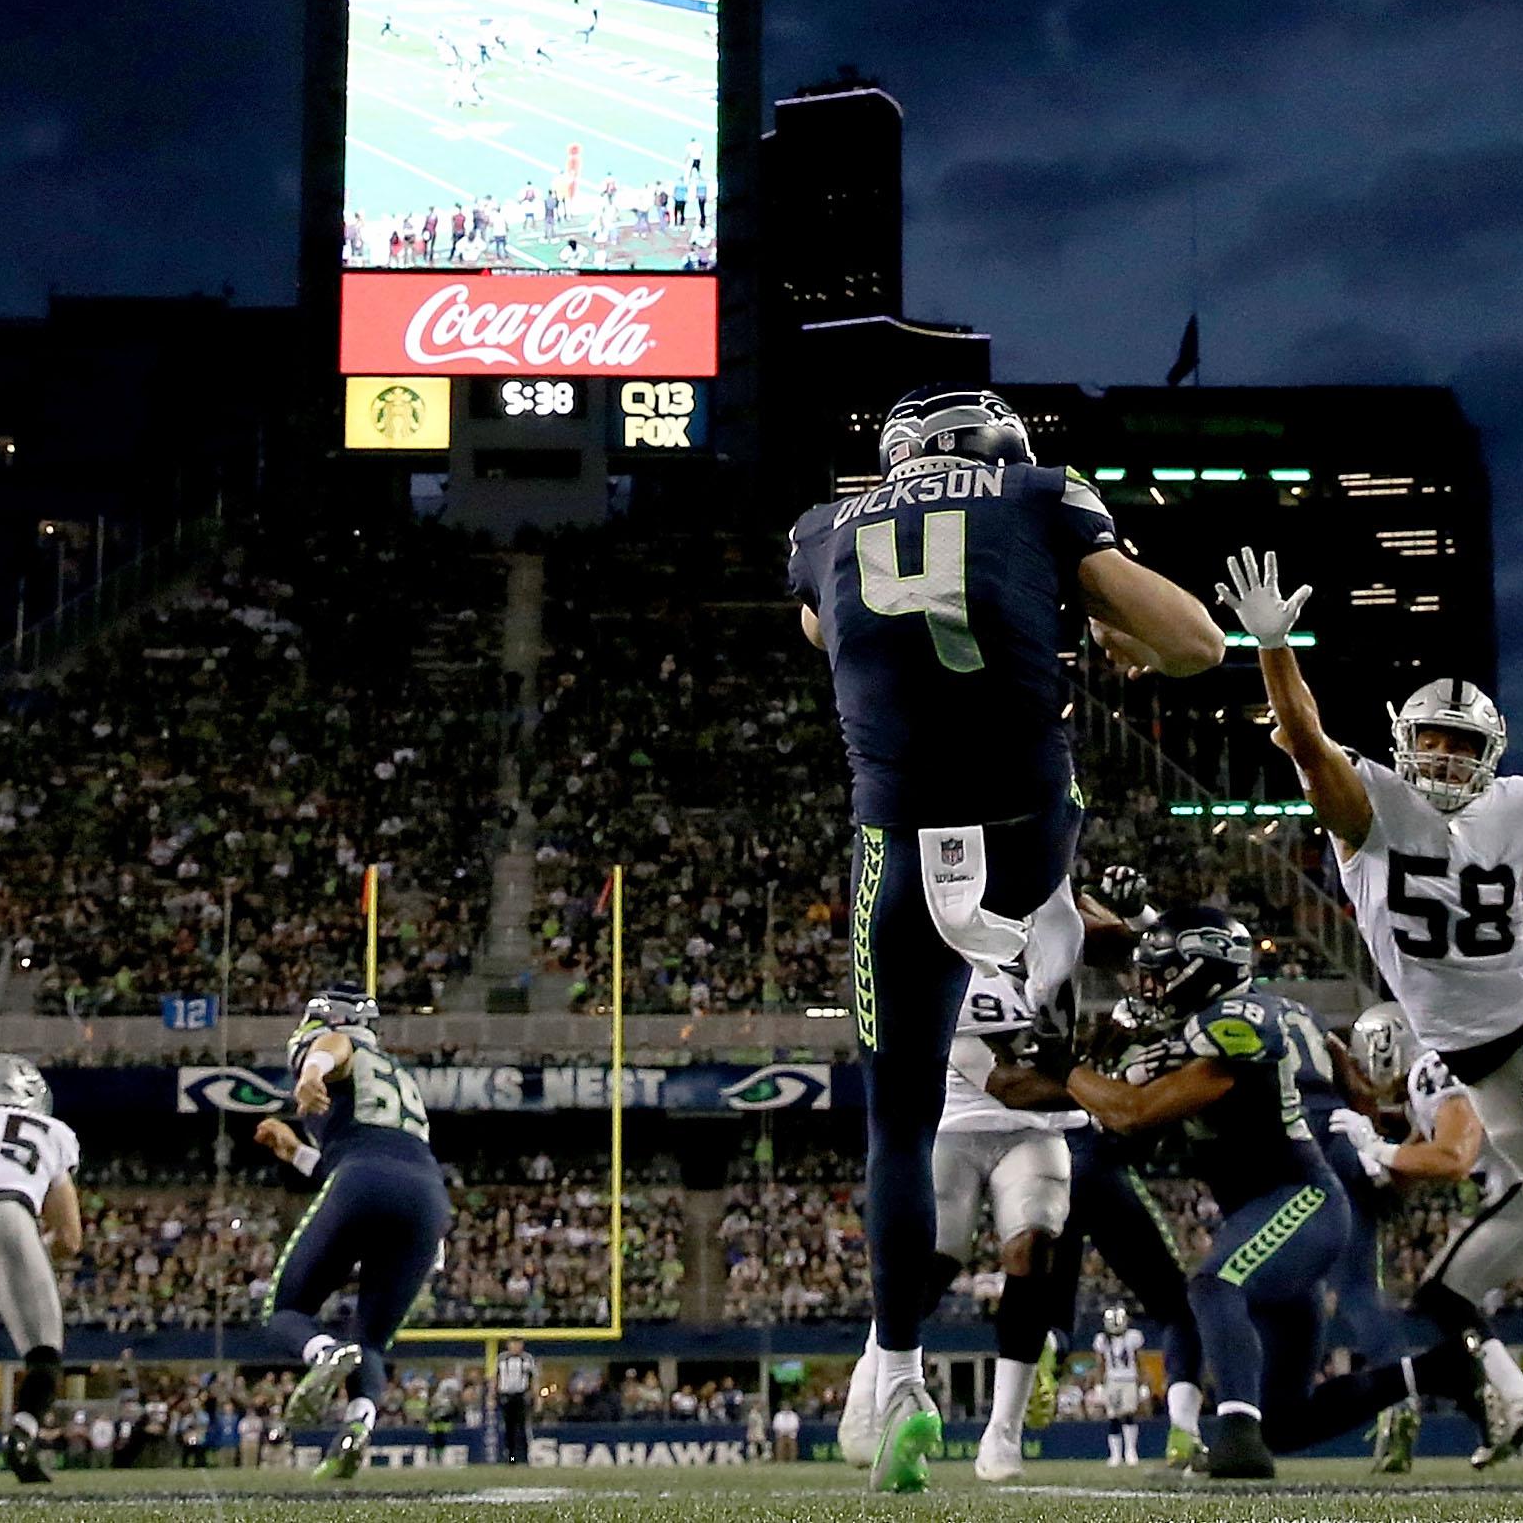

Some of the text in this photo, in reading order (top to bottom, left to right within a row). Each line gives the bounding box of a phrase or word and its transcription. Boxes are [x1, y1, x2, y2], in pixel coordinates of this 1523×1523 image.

[404, 284, 667, 366] Coca-Cola
[621, 382, 695, 417] Q13
[624, 416, 691, 447] FOX
[833, 467, 1005, 530] DICKSON
[856, 510, 985, 673] 4
[1386, 848, 1516, 959] 58
[173, 998, 207, 1029] 12
[414, 1065, 667, 1110] WKS NEST
